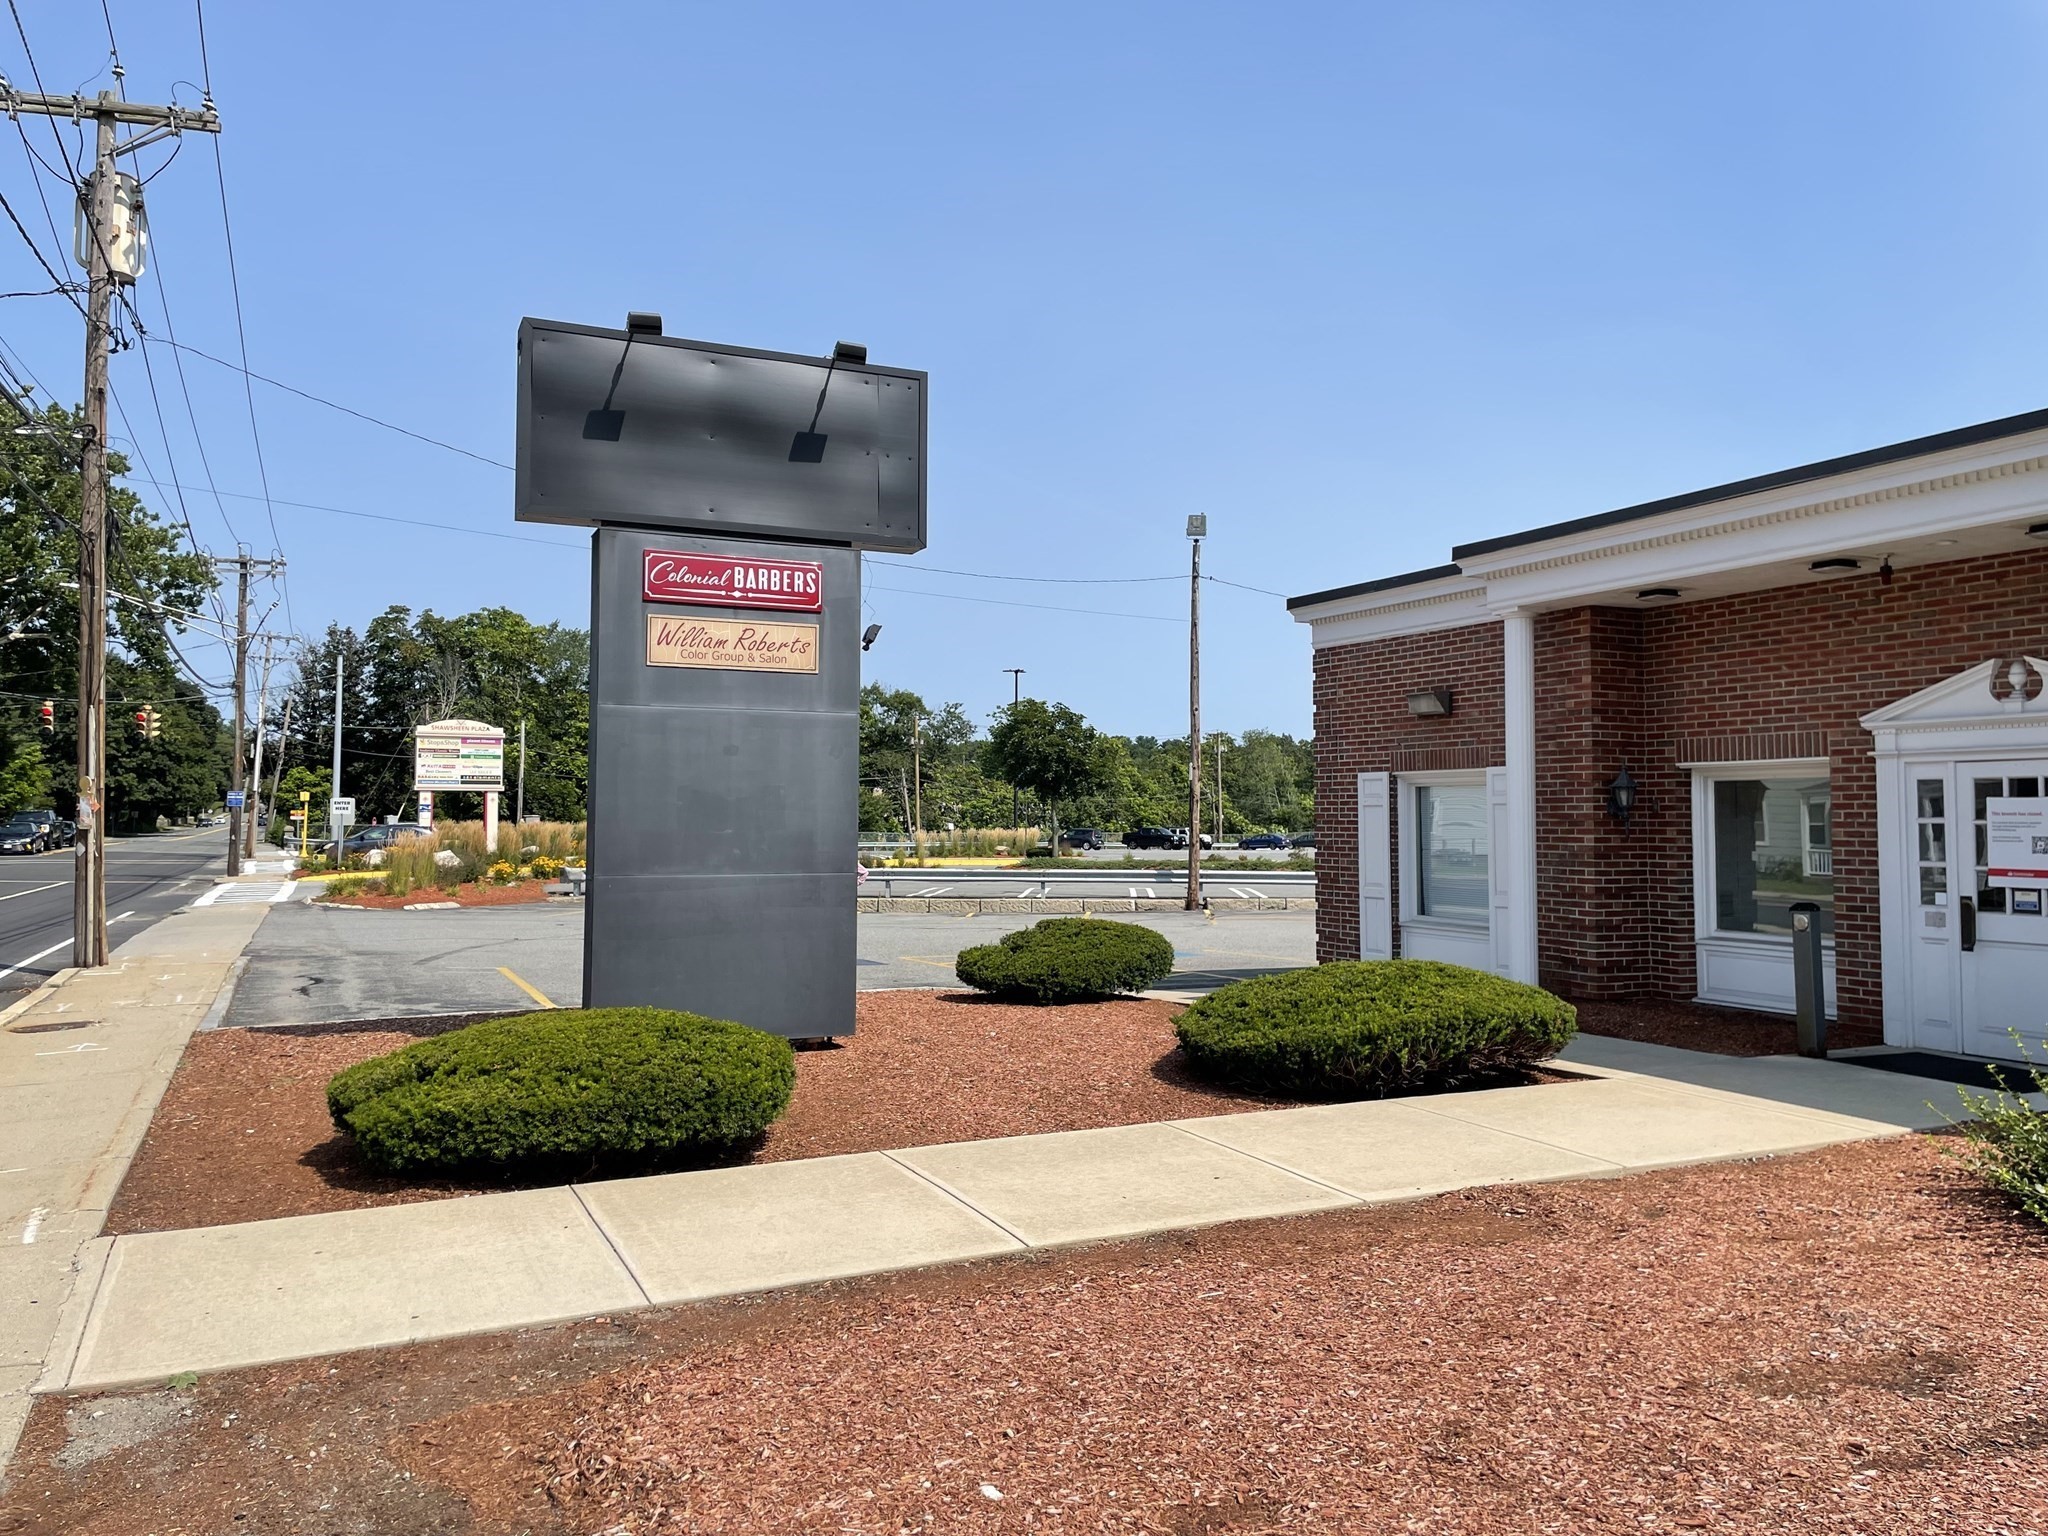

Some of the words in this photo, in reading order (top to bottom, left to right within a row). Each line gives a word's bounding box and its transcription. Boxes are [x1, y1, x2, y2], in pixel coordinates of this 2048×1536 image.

[650, 560, 731, 586] Colonial
[734, 566, 816, 594] BARBERS
[656, 622, 728, 649] William
[734, 628, 811, 654] Roberts
[680, 649, 707, 660] Color
[712, 651, 744, 663] Group
[748, 653, 755, 662] &
[759, 653, 787, 664] Salon
